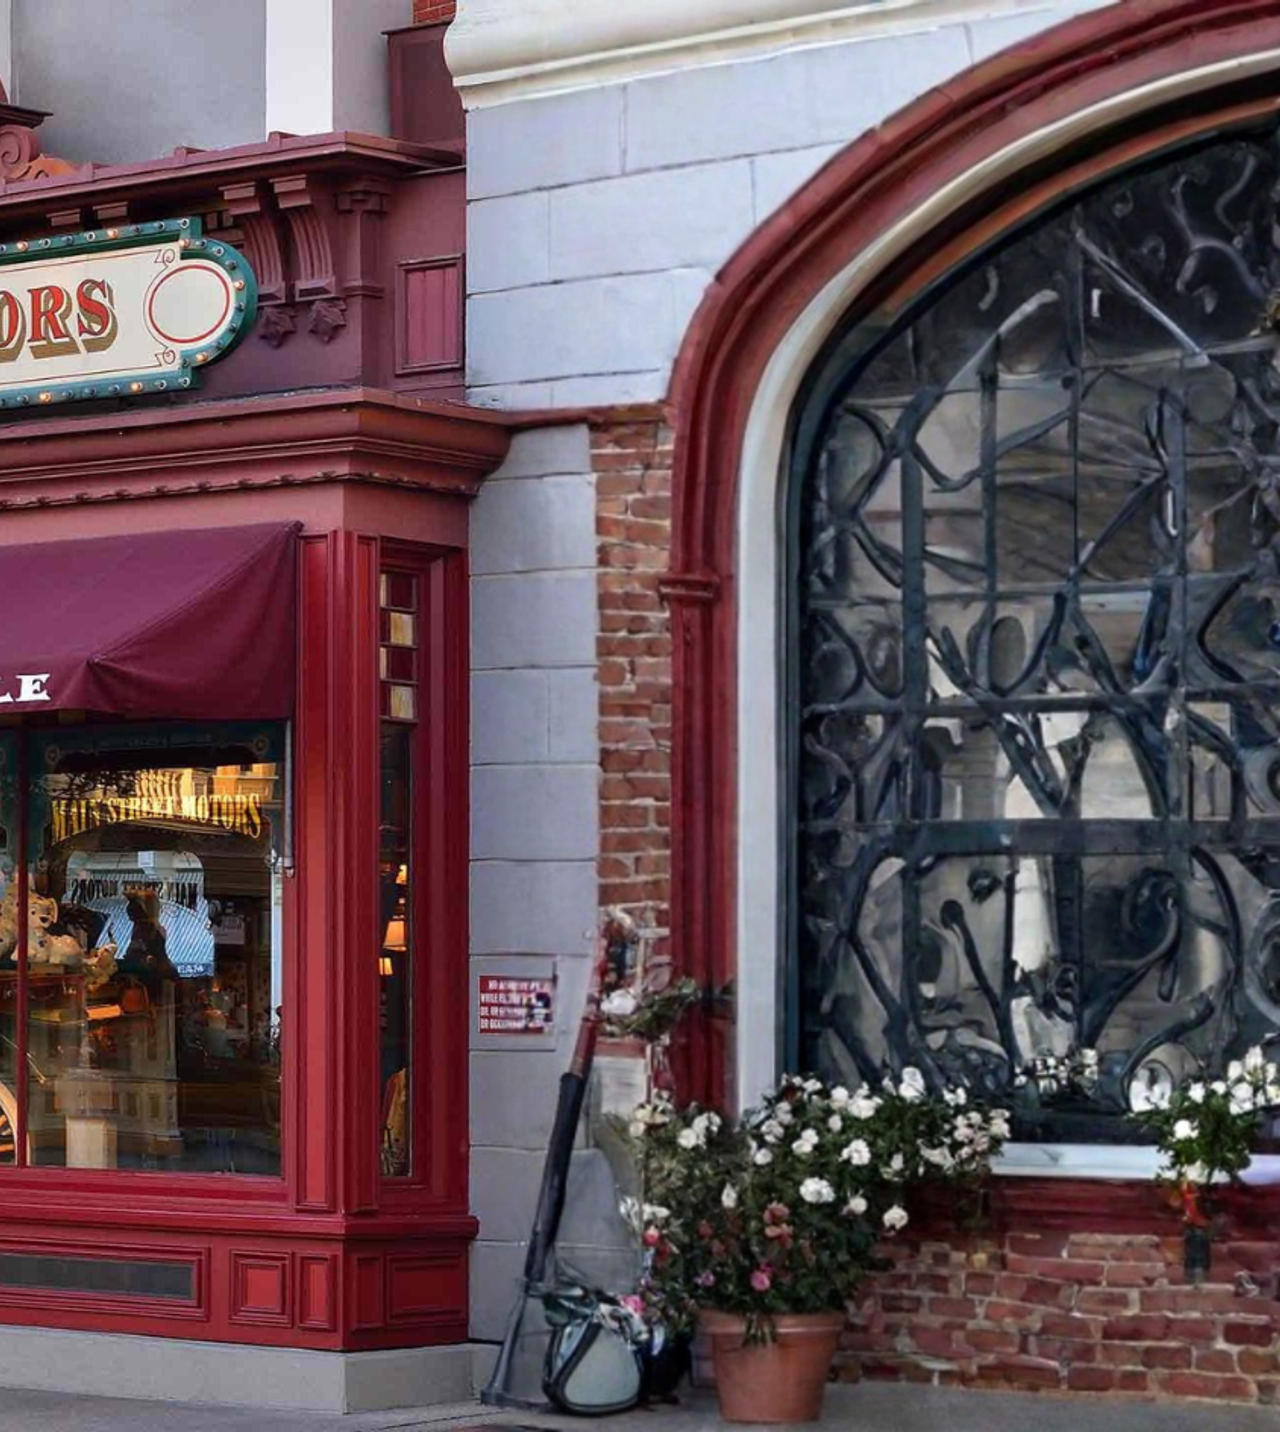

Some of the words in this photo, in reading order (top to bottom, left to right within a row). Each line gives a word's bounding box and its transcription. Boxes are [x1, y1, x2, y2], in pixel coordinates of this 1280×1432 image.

[51, 799, 103, 846] MAIN
[106, 796, 175, 825] STREET
[181, 793, 262, 839] MOTORS
